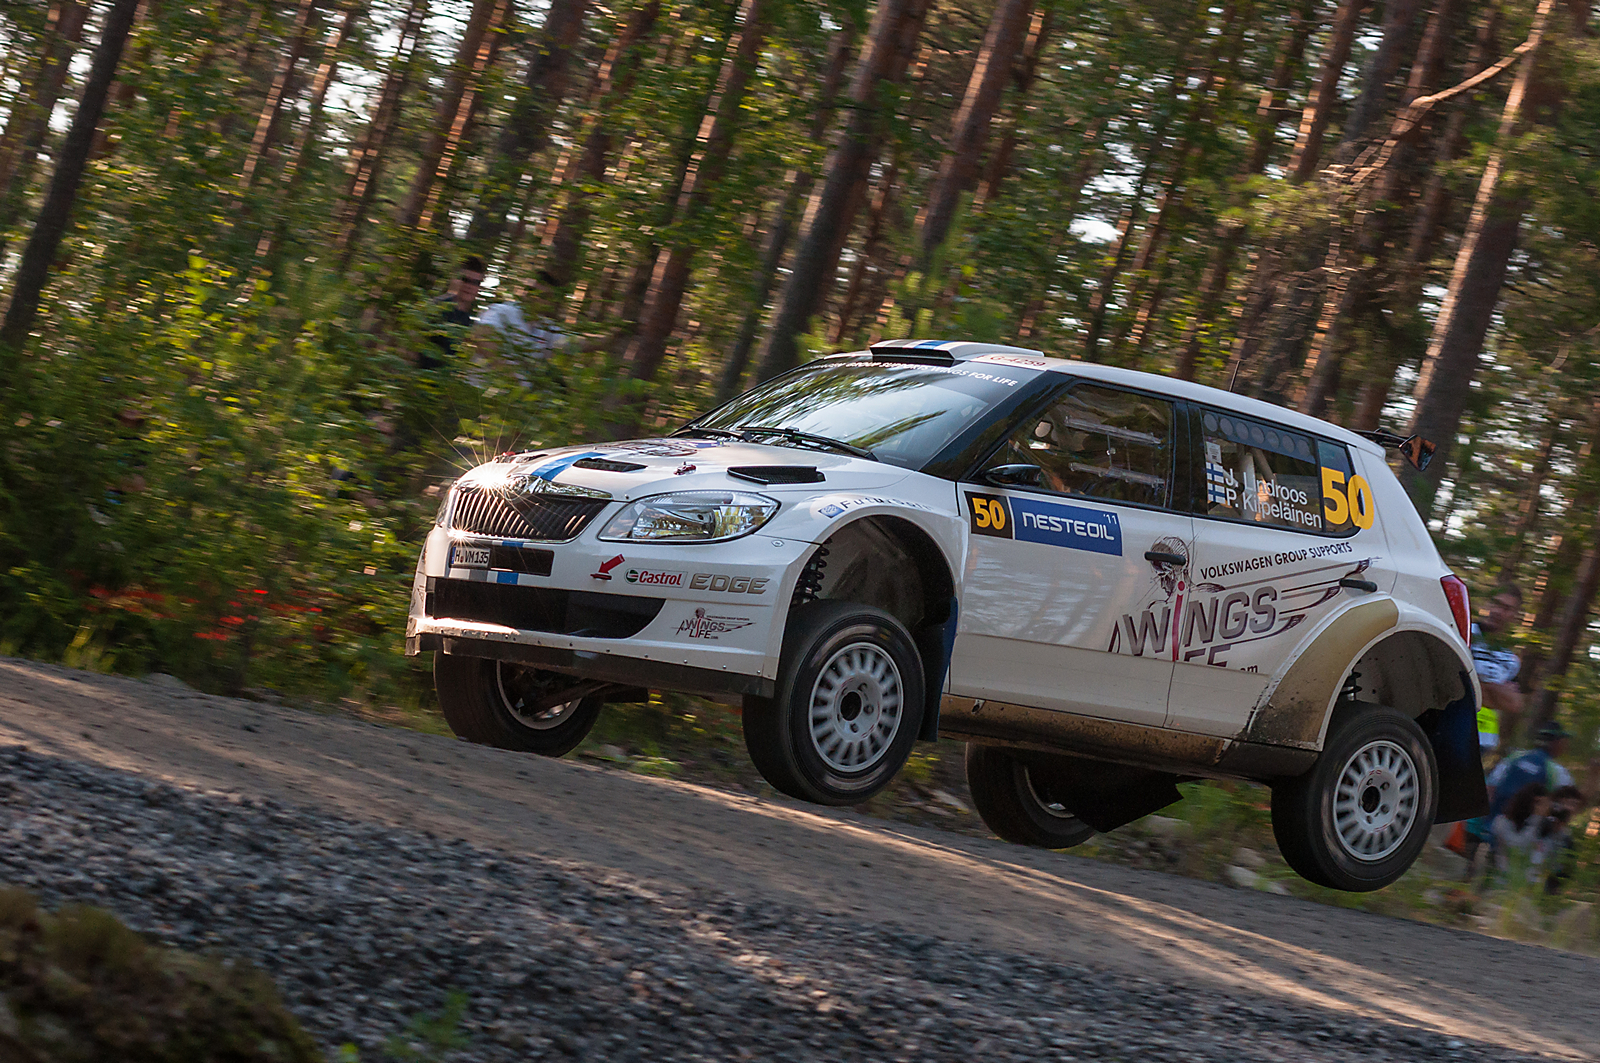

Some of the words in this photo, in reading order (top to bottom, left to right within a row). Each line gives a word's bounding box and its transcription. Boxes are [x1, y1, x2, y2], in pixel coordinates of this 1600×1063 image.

[968, 371, 993, 381] FOR
[992, 376, 1018, 387] LIFE
[1225, 468, 1239, 488] J.
[1243, 471, 1308, 506] Lindroos
[1226, 487, 1239, 508] P.
[1320, 466, 1375, 530] 50
[972, 497, 1006, 530] 50
[1200, 554, 1273, 580] VOLKSWAGEN
[1274, 549, 1308, 566] GROUP
[1309, 541, 1353, 559] SUPPORTS
[638, 569, 683, 587] Castrol
[689, 572, 771, 595] EDGE
[686, 619, 726, 632] WINGS
[1122, 585, 1278, 661] WINGS
